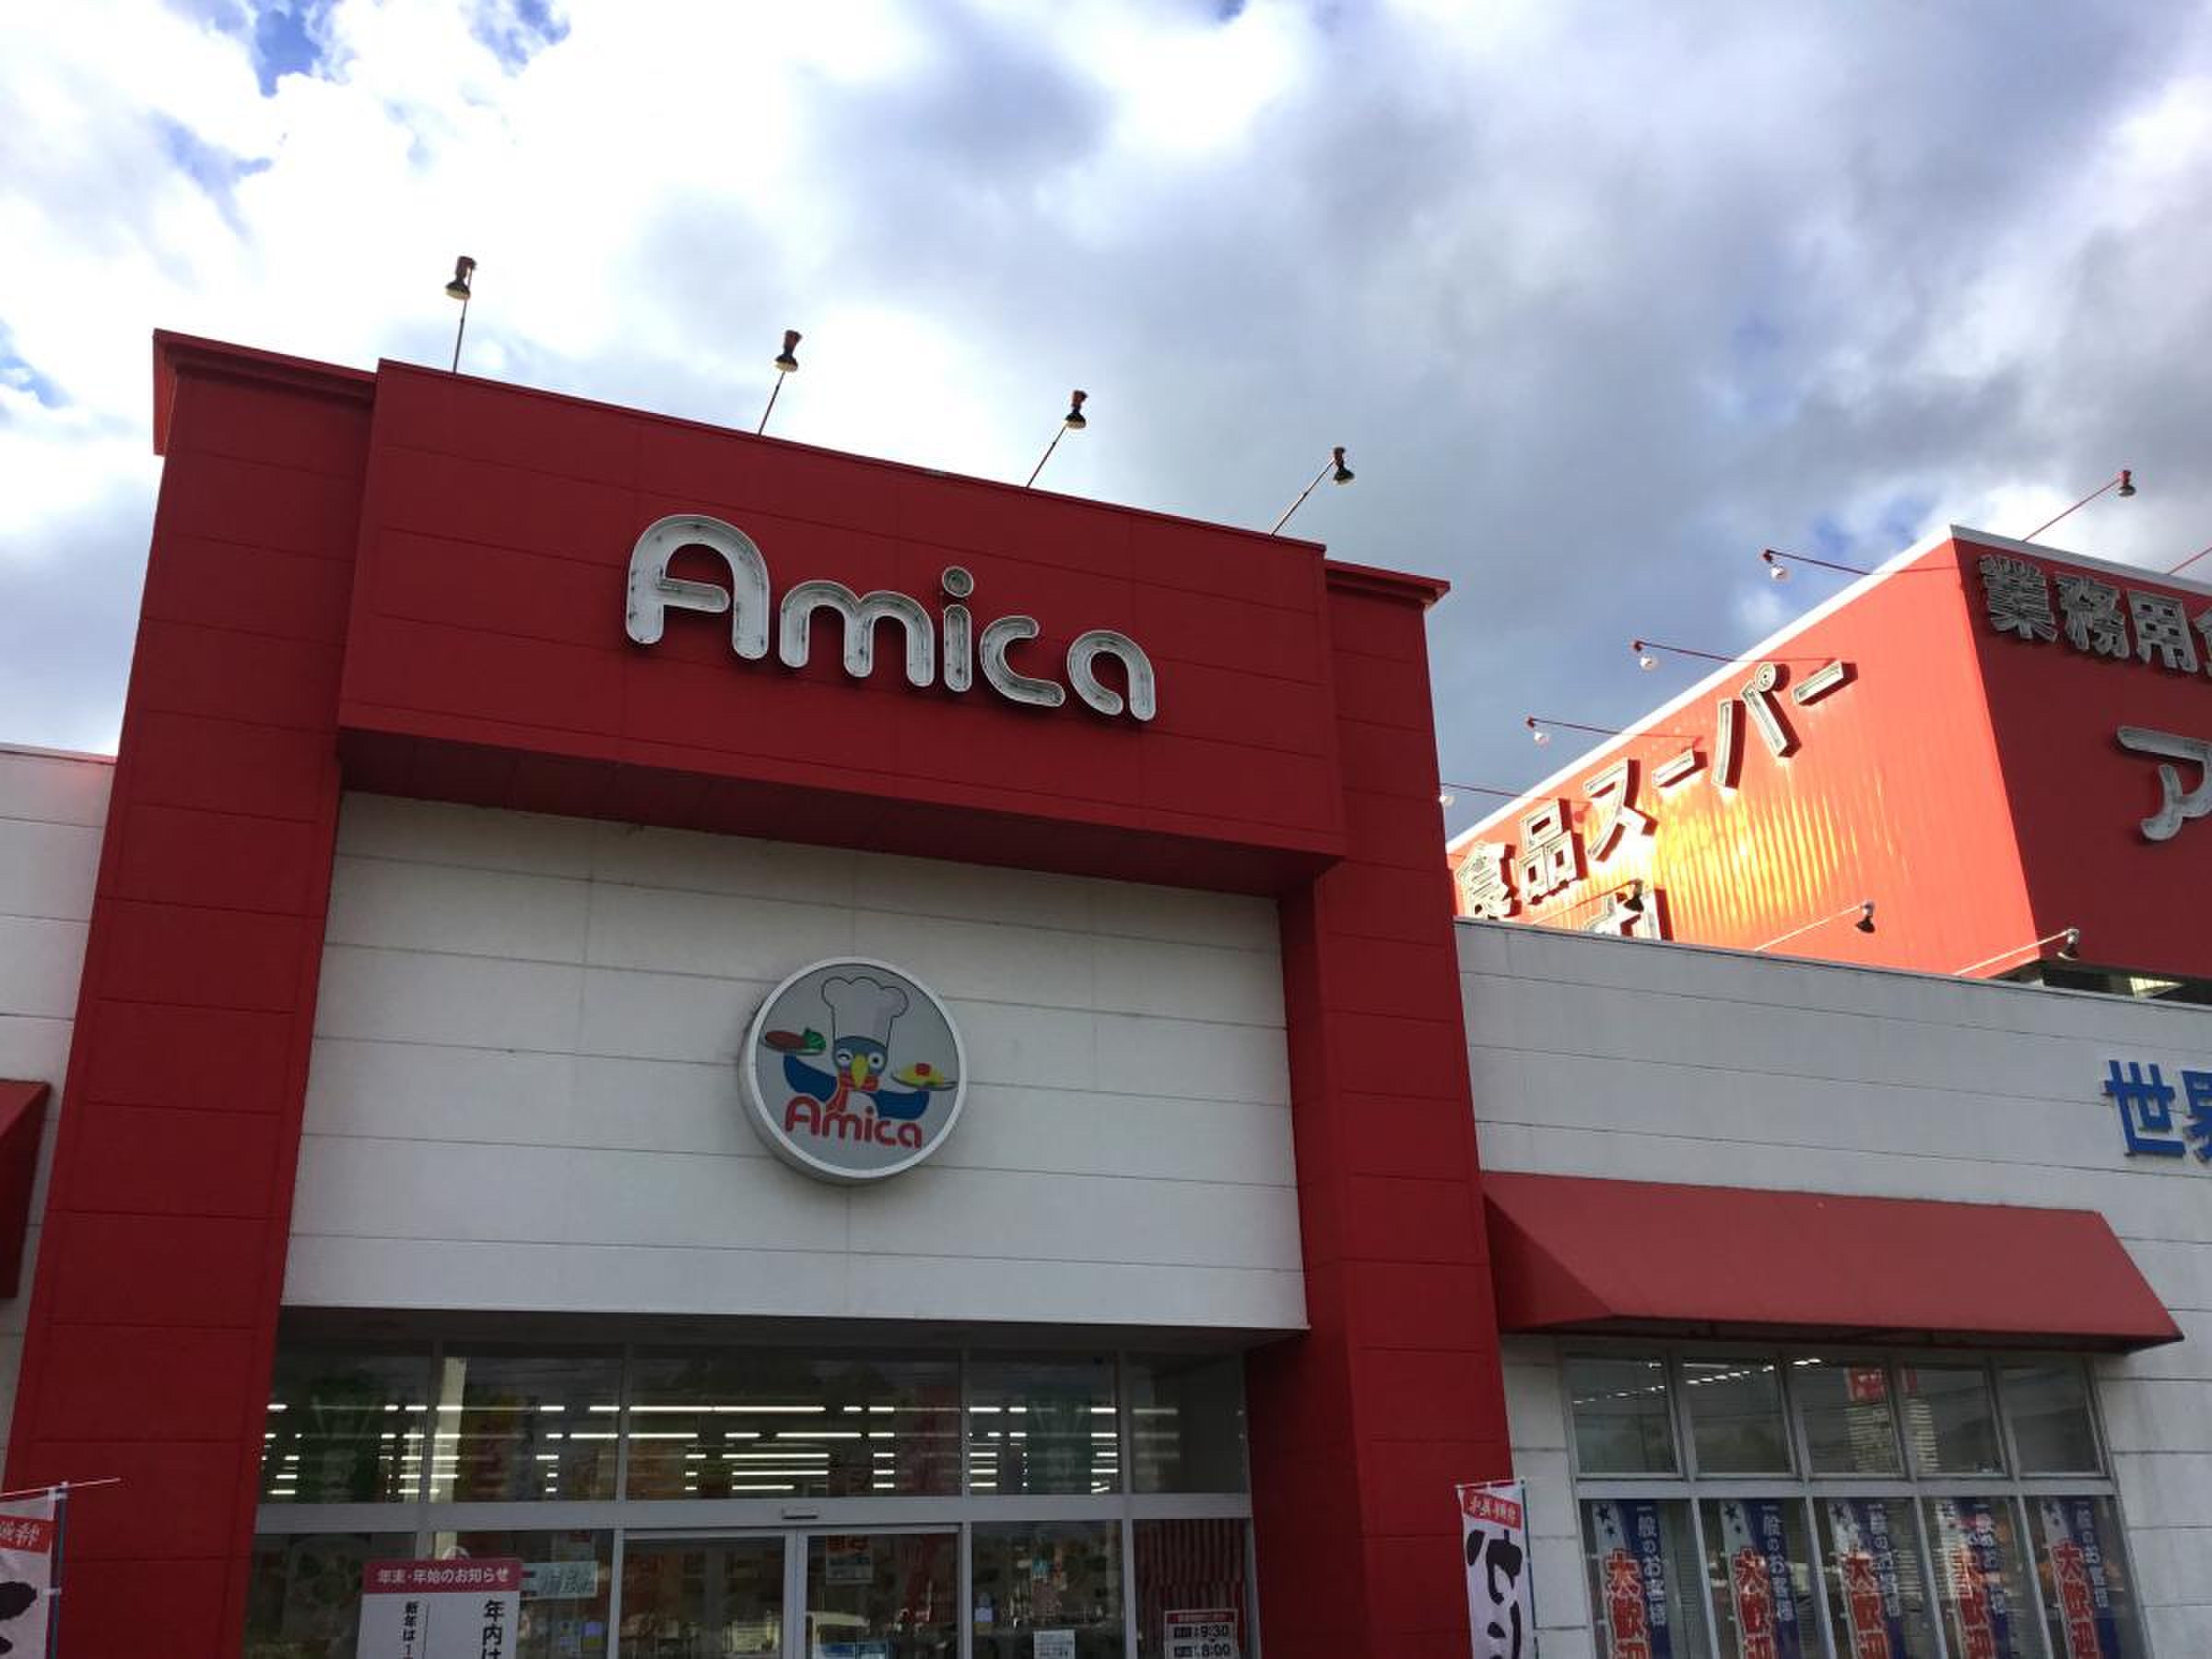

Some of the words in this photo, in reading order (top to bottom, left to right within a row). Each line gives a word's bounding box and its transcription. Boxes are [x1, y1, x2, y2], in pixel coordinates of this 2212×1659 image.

[625, 513, 1157, 722] Amica
[1978, 554, 2212, 677] 業務用
[1455, 661, 1851, 920] 食品スーパー
[784, 1095, 924, 1148] Amica
